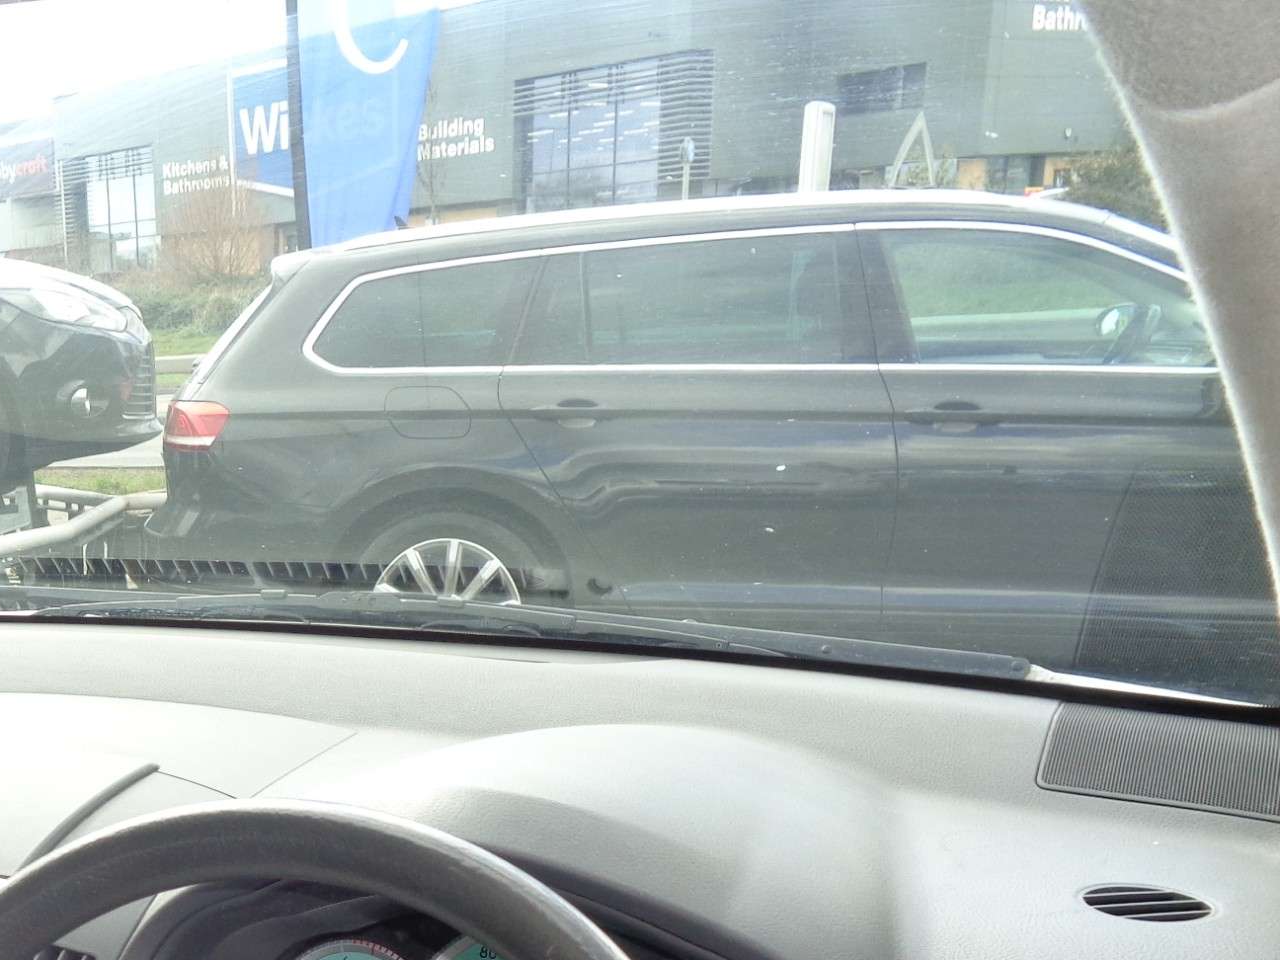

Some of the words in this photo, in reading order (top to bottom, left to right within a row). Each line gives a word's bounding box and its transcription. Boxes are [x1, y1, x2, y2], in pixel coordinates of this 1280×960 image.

[418, 116, 485, 141] Building
[417, 134, 495, 161] Materials
[162, 158, 218, 180] Kitchens
